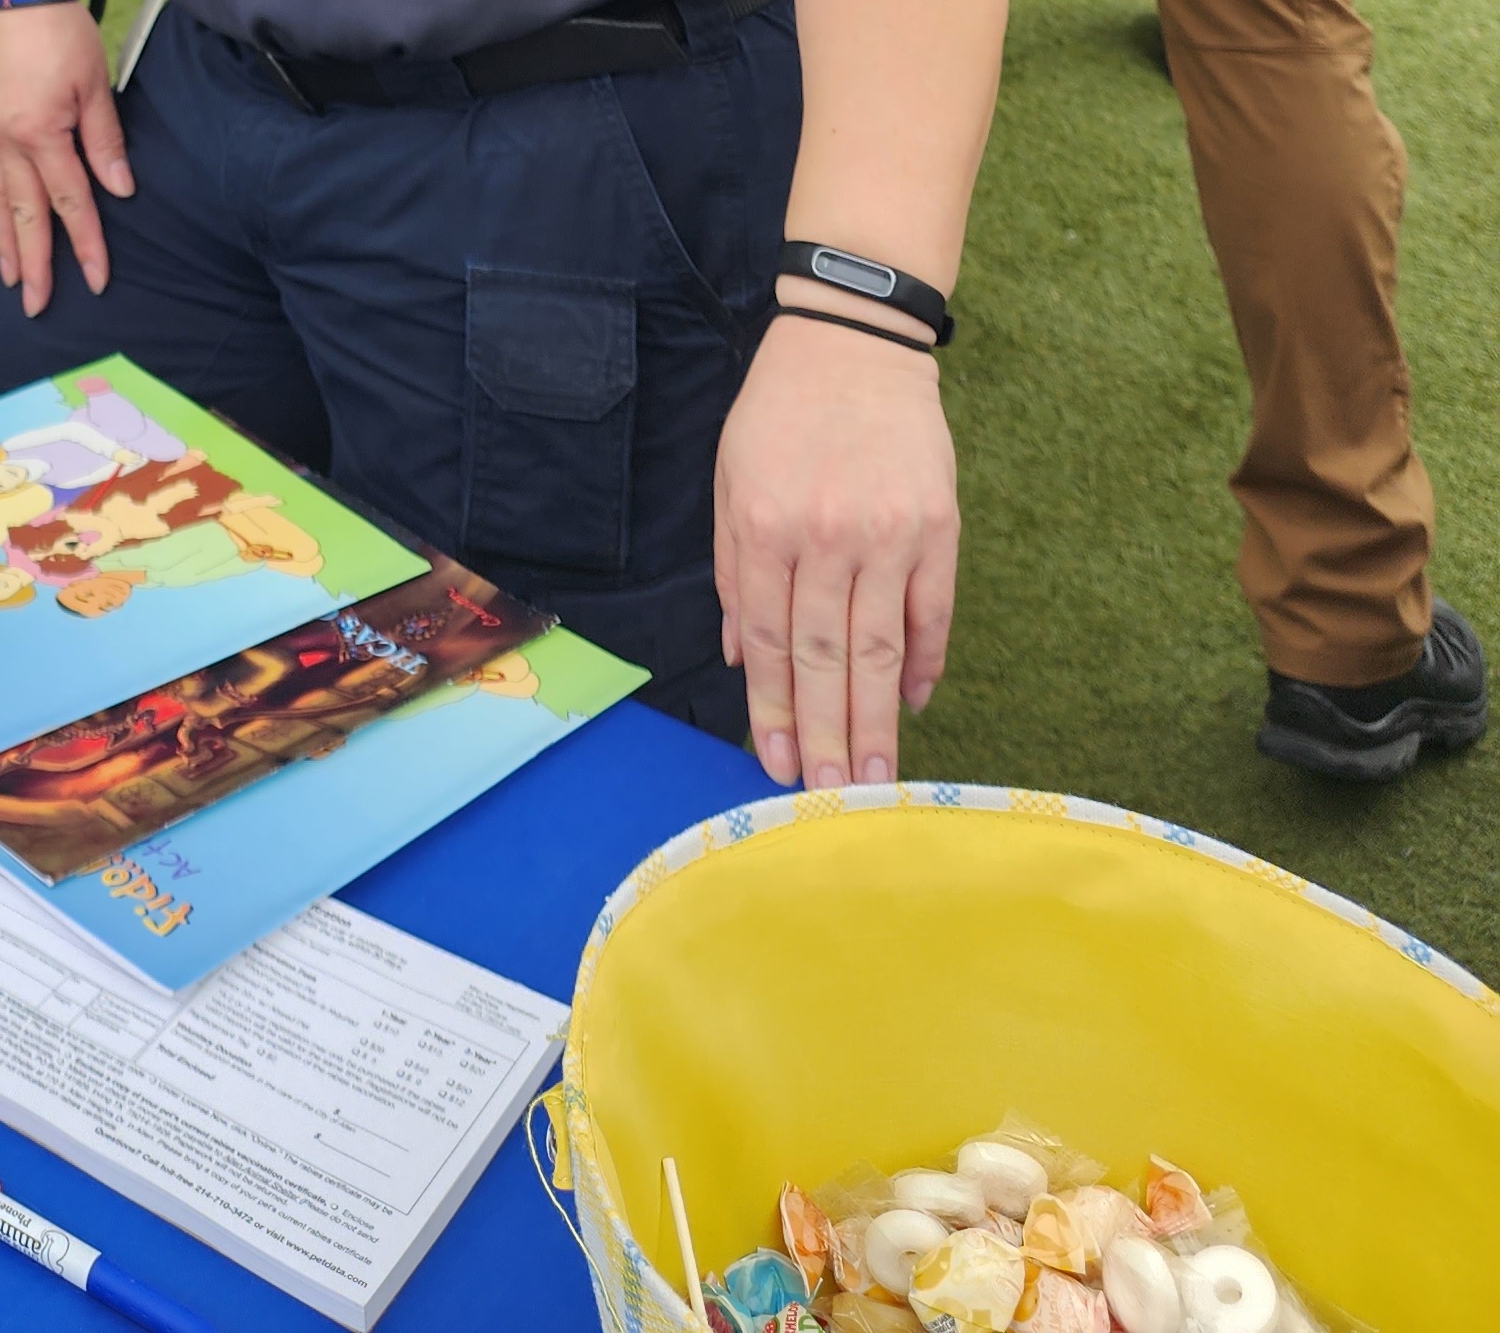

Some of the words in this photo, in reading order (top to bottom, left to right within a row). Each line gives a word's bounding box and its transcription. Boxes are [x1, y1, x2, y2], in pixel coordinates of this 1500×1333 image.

[234, 1150, 284, 1181] vaccination
[340, 1208, 376, 1232] Enclose
[323, 1174, 363, 1201] certificate
[360, 1195, 381, 1211] may
[380, 1205, 394, 1216] be
[238, 1187, 258, 1203] your
[255, 1197, 278, 1215] pet's
[276, 1208, 307, 1231] current
[305, 1224, 333, 1245] rabies
[331, 1238, 373, 1268] certificate
[252, 1220, 265, 1231] or
[264, 1226, 286, 1243] visit
[284, 1236, 369, 1291] www.petdata.com
[328, 1212, 342, 1224] do
[340, 1219, 358, 1233] not
[356, 1227, 380, 1245] send
